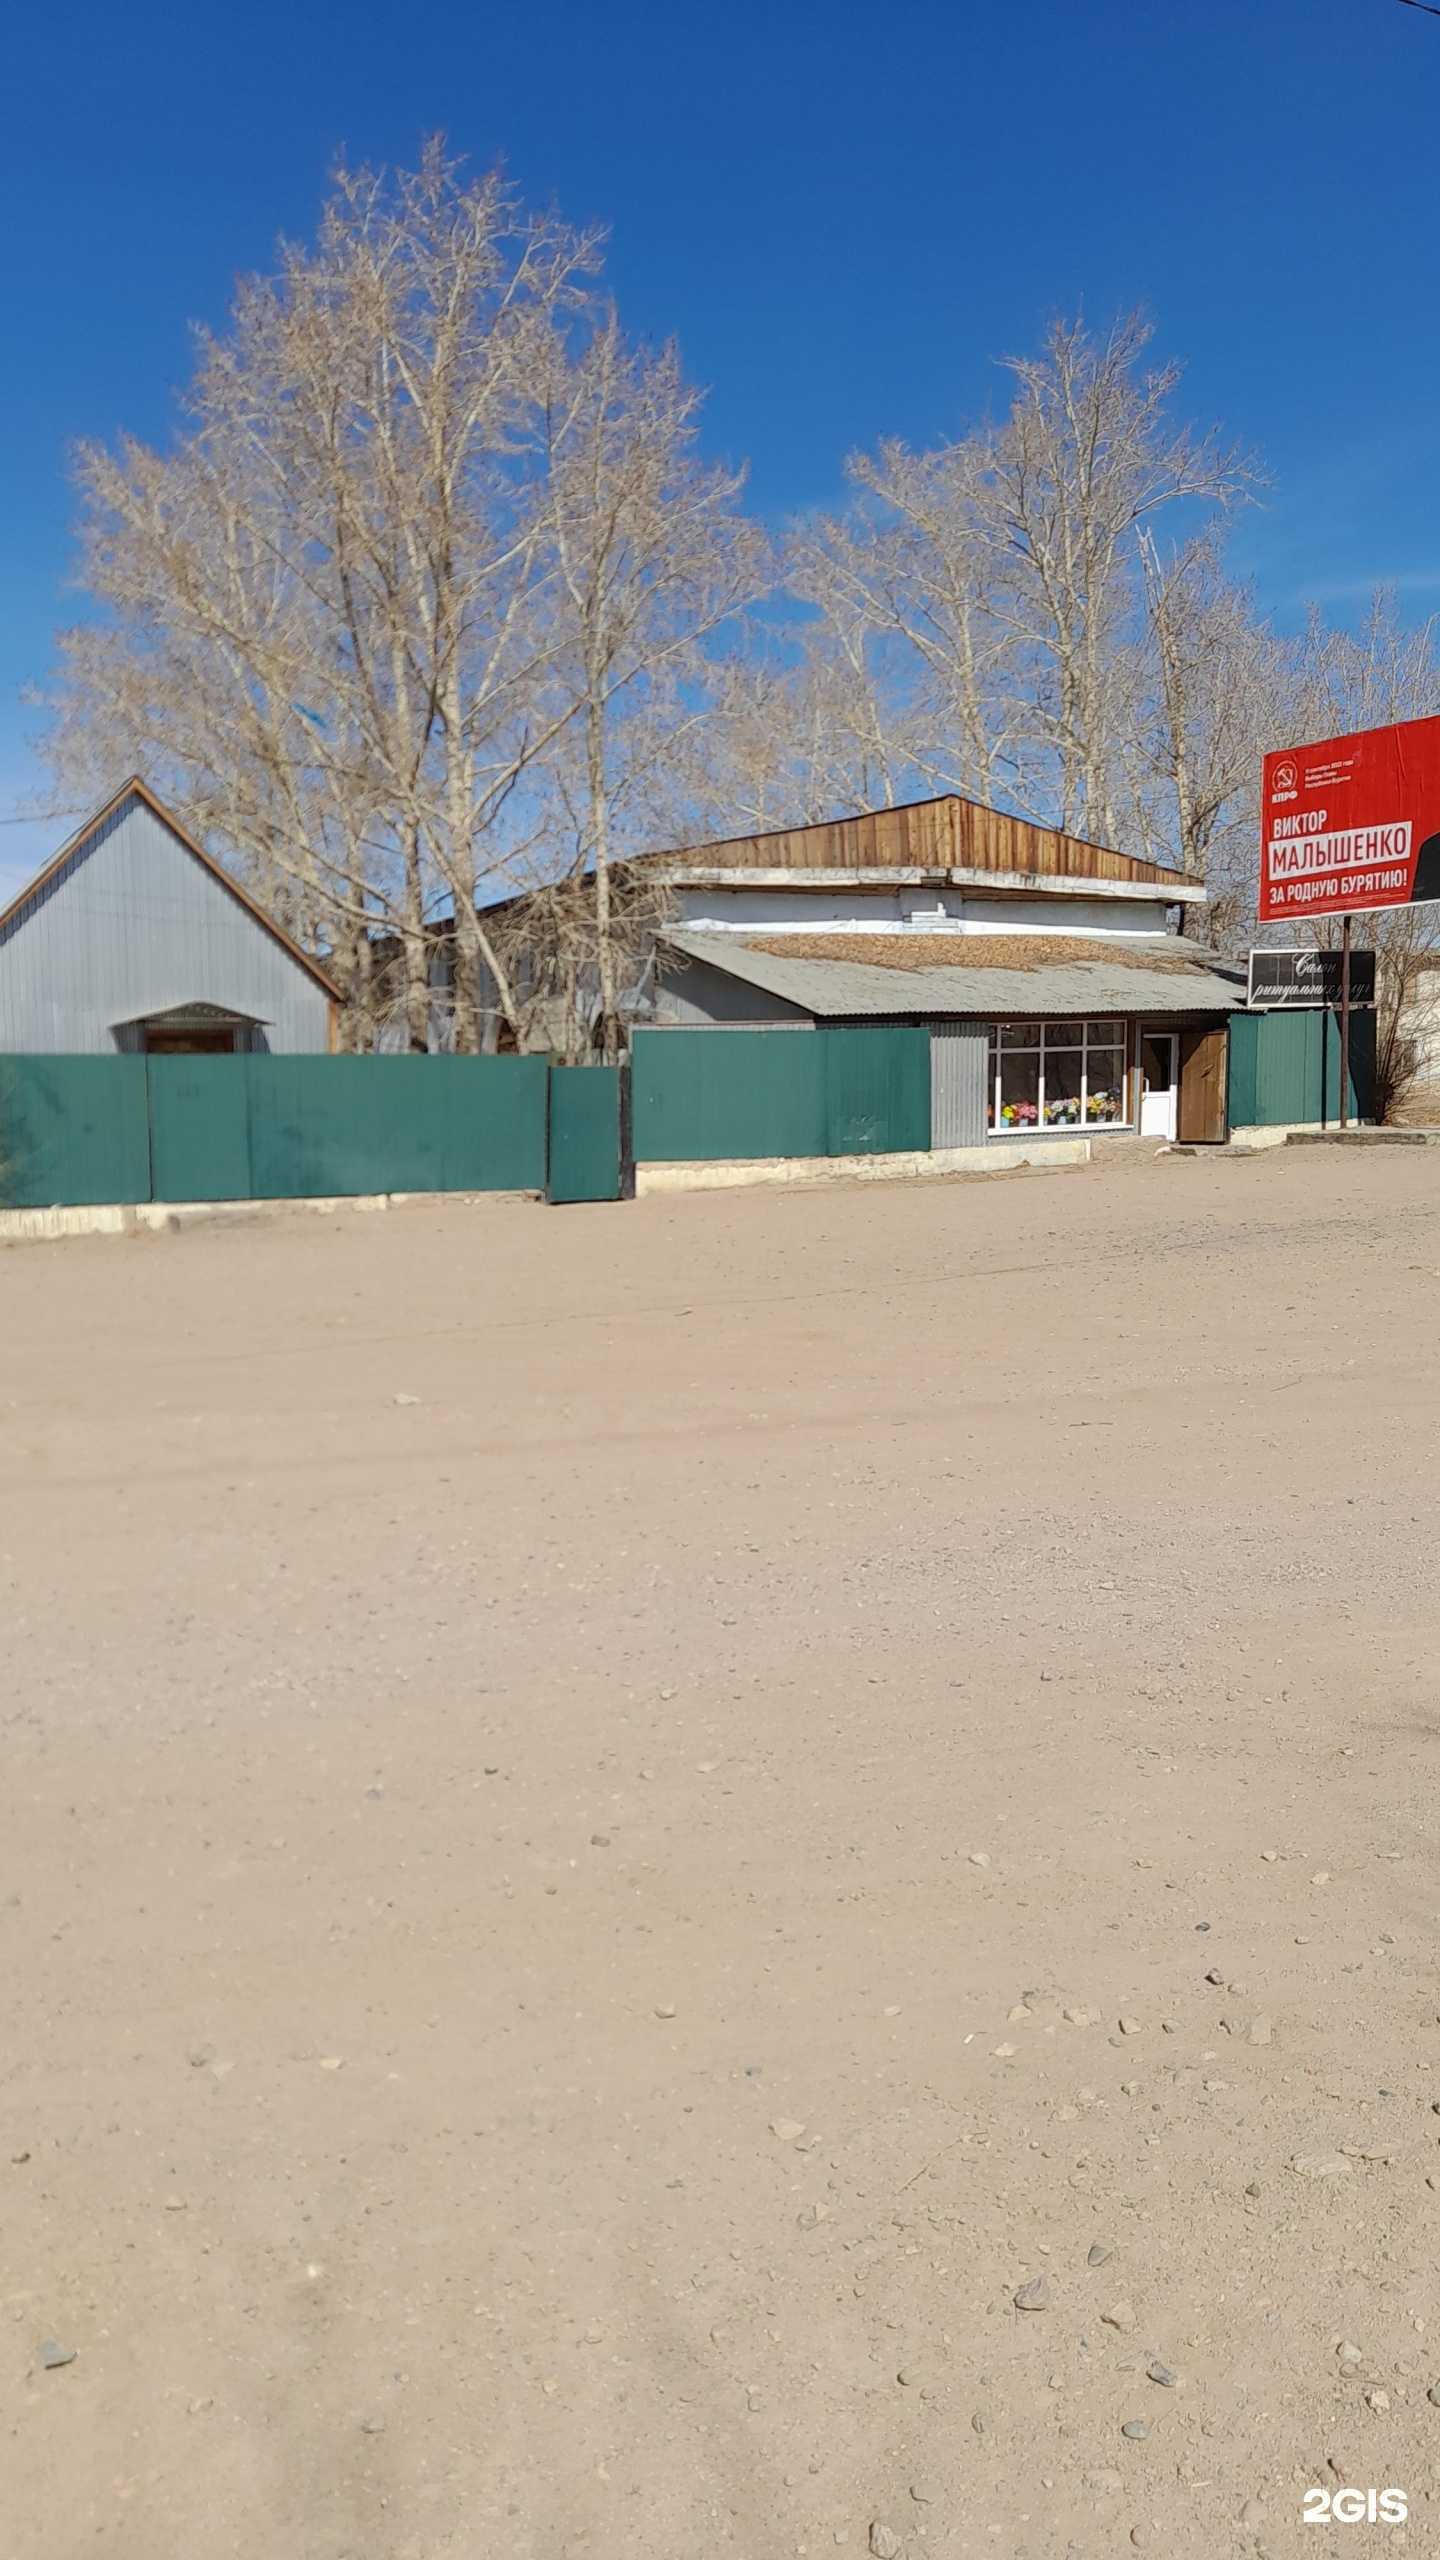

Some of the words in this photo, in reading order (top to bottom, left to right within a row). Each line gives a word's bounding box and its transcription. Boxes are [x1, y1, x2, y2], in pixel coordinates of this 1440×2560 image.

[1271, 790, 1298, 804] КПРФ
[1273, 809, 1328, 839] ВИКТОР
[1272, 827, 1407, 874] МАЛЫШЕНКО
[1269, 886, 1286, 905] ЗА
[1287, 879, 1338, 904] РОДНУЮ
[1341, 868, 1408, 895] БУРЯТИЮ!
[1292, 953, 1337, 977] Салон
